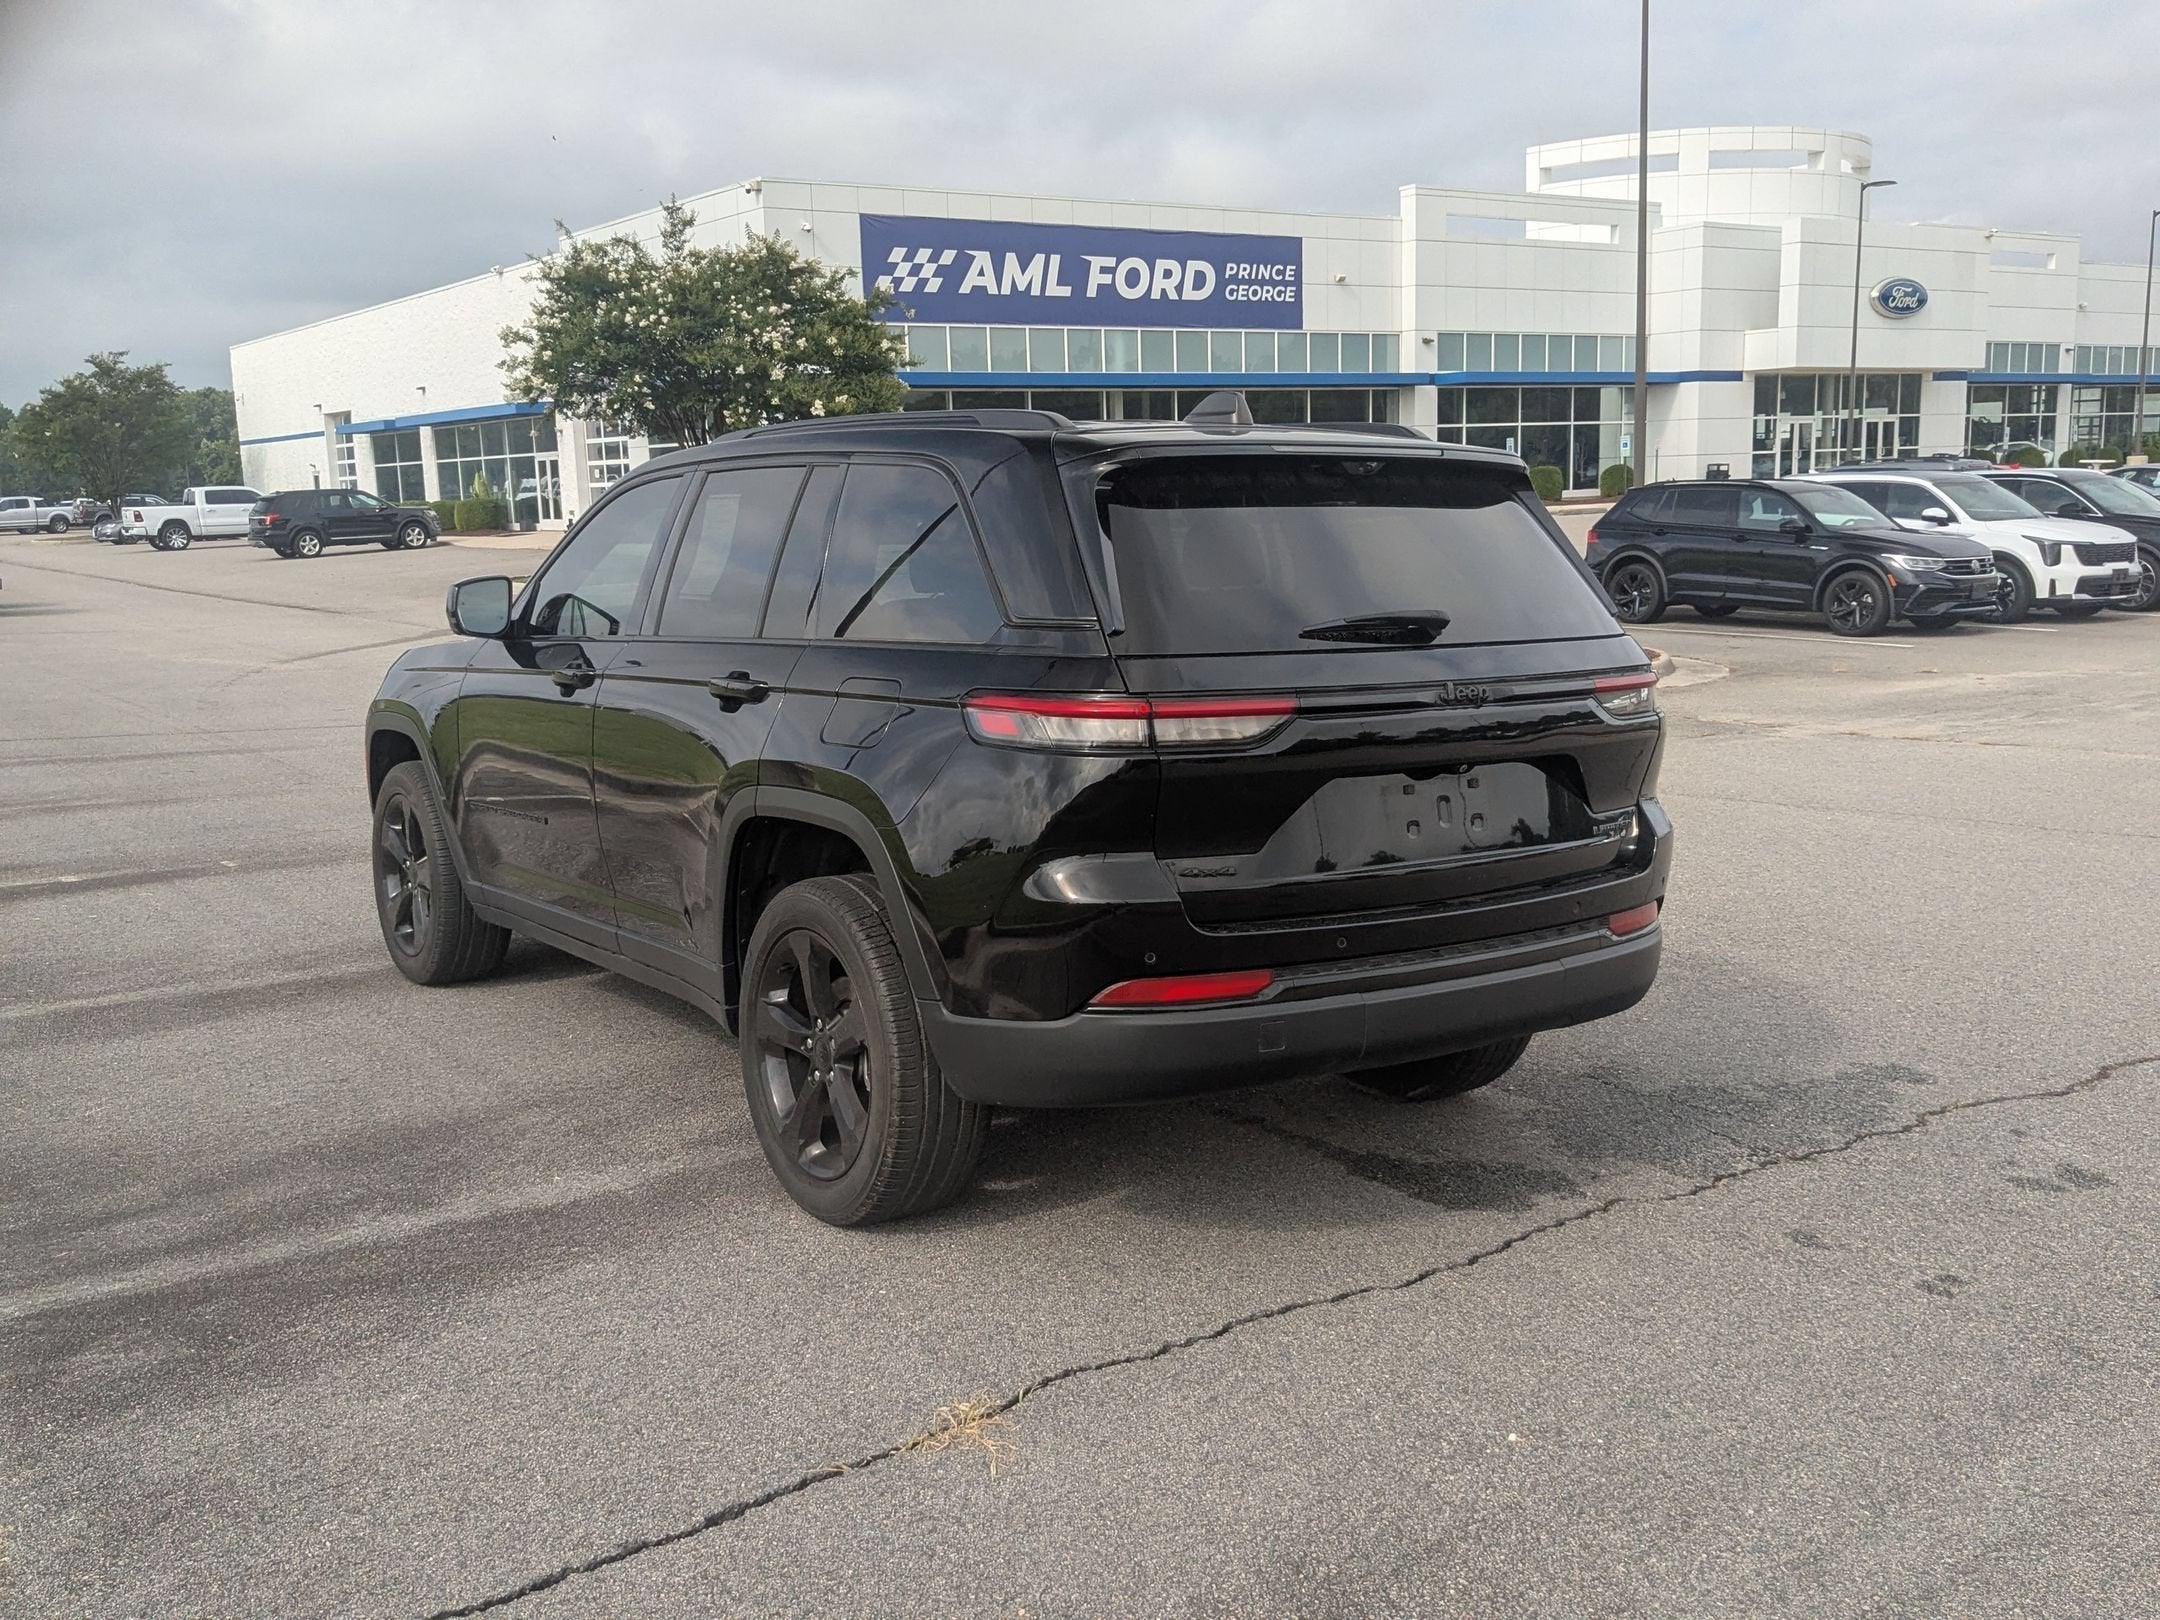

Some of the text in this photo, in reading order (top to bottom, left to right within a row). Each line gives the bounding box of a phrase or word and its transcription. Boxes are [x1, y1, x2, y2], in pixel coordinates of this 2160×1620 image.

[958, 249, 1216, 301] AML FORD
[1225, 262, 1296, 281] PRINCE
[1225, 284, 1296, 302] GEORGE
[1888, 286, 1919, 308] Ford
[1440, 681, 1489, 705] Jeep
